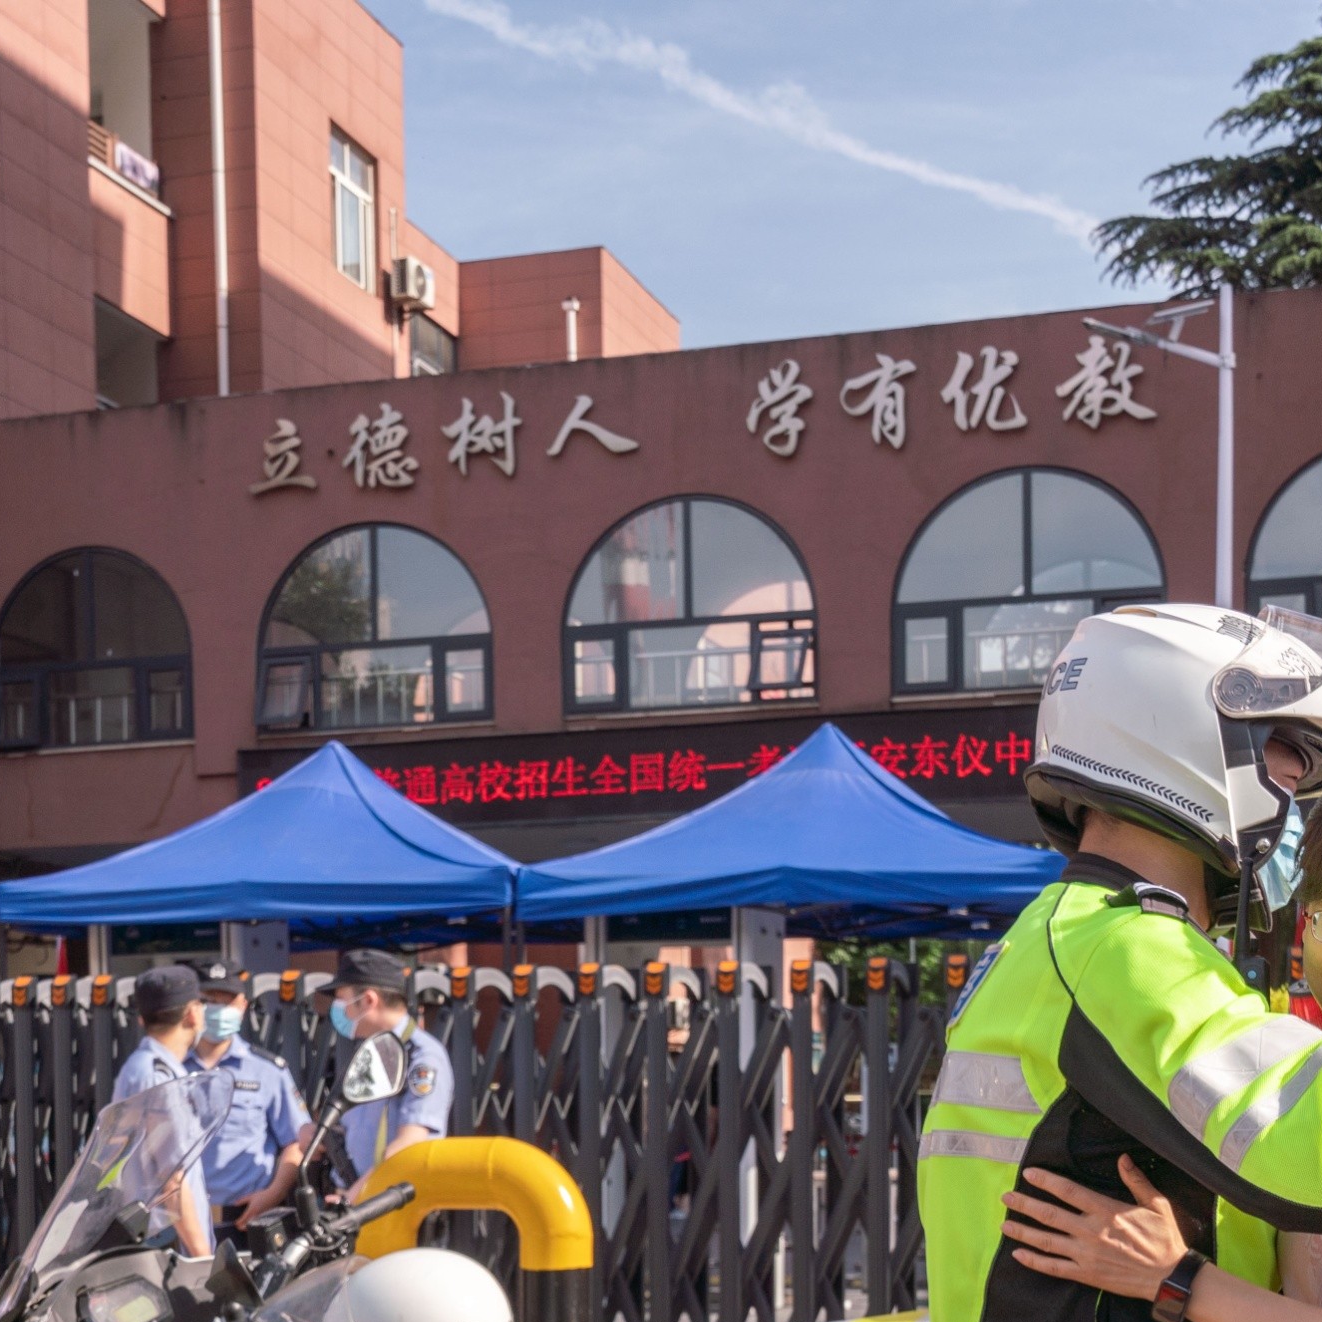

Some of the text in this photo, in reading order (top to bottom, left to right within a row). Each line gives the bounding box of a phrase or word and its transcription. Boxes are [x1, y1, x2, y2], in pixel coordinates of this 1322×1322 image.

[249, 335, 1158, 496] 立德树人 学有优教
[1045, 657, 1087, 699] CE
